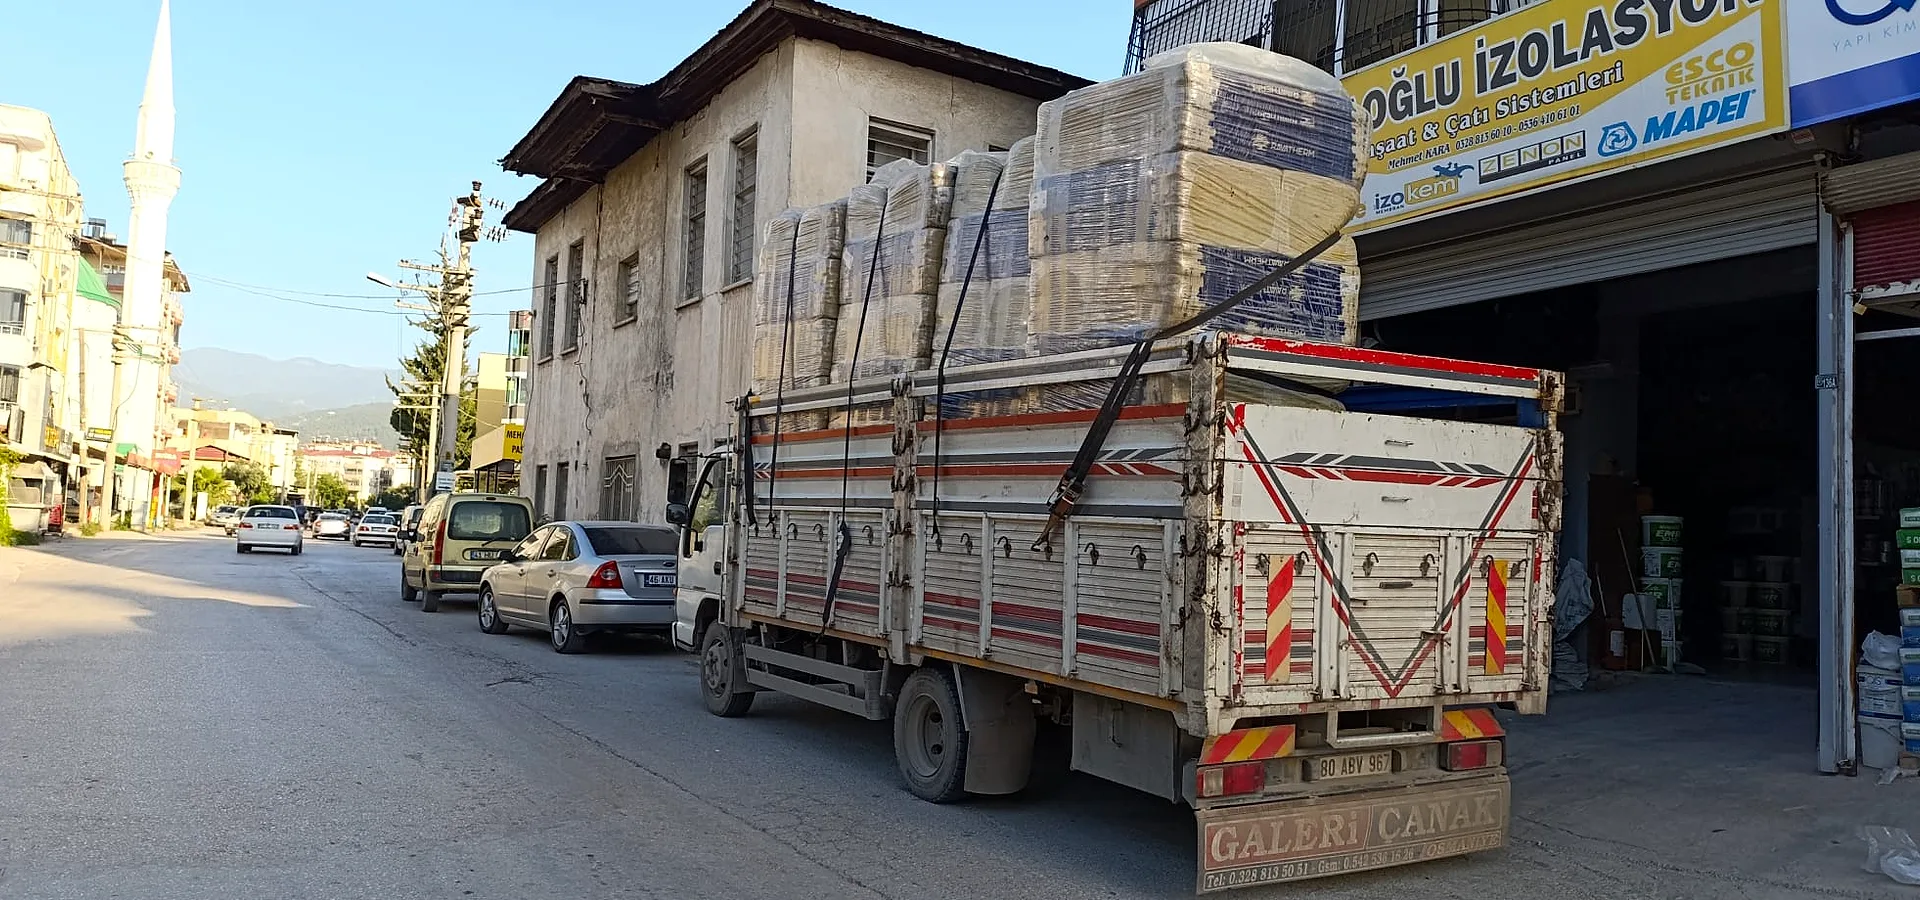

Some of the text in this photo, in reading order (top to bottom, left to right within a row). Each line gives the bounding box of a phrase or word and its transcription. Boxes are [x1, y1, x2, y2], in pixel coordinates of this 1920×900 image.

[1833, 31, 1871, 53] YAPI
[1362, 0, 1759, 130] OĞLU İZOLASY
[1665, 42, 1755, 84] ESCO
[1421, 121, 1440, 142] &
[1444, 106, 1490, 138] Çatı
[1495, 60, 1624, 119] Sistemleri
[1642, 90, 1751, 144] MAPEI
[1270, 141, 1316, 157] RAVATHERM
[1388, 152, 1422, 169] Mehmet
[1425, 143, 1450, 159] KARA
[1455, 137, 1474, 150] 0328
[1475, 132, 1489, 145] 813
[1490, 128, 1501, 139] 60
[1502, 125, 1512, 136] 10
[1518, 117, 1538, 132] 0536
[1540, 112, 1556, 125] 410
[1557, 108, 1567, 120] 61
[1569, 104, 1580, 116] 01
[1482, 135, 1582, 174] ZENON
[1548, 152, 1582, 166] PANEL
[1320, 753, 1390, 777] 80 ABV 967
[1378, 796, 1496, 843] ÇANAK
[1207, 873, 1226, 888] Tel:
[1229, 869, 1257, 884] 0.328
[1260, 866, 1279, 881] 813
[1281, 864, 1295, 878] 50
[1296, 863, 1308, 876] 51
[1318, 860, 1341, 873] Gsm:
[1343, 853, 1371, 870] 0.542
